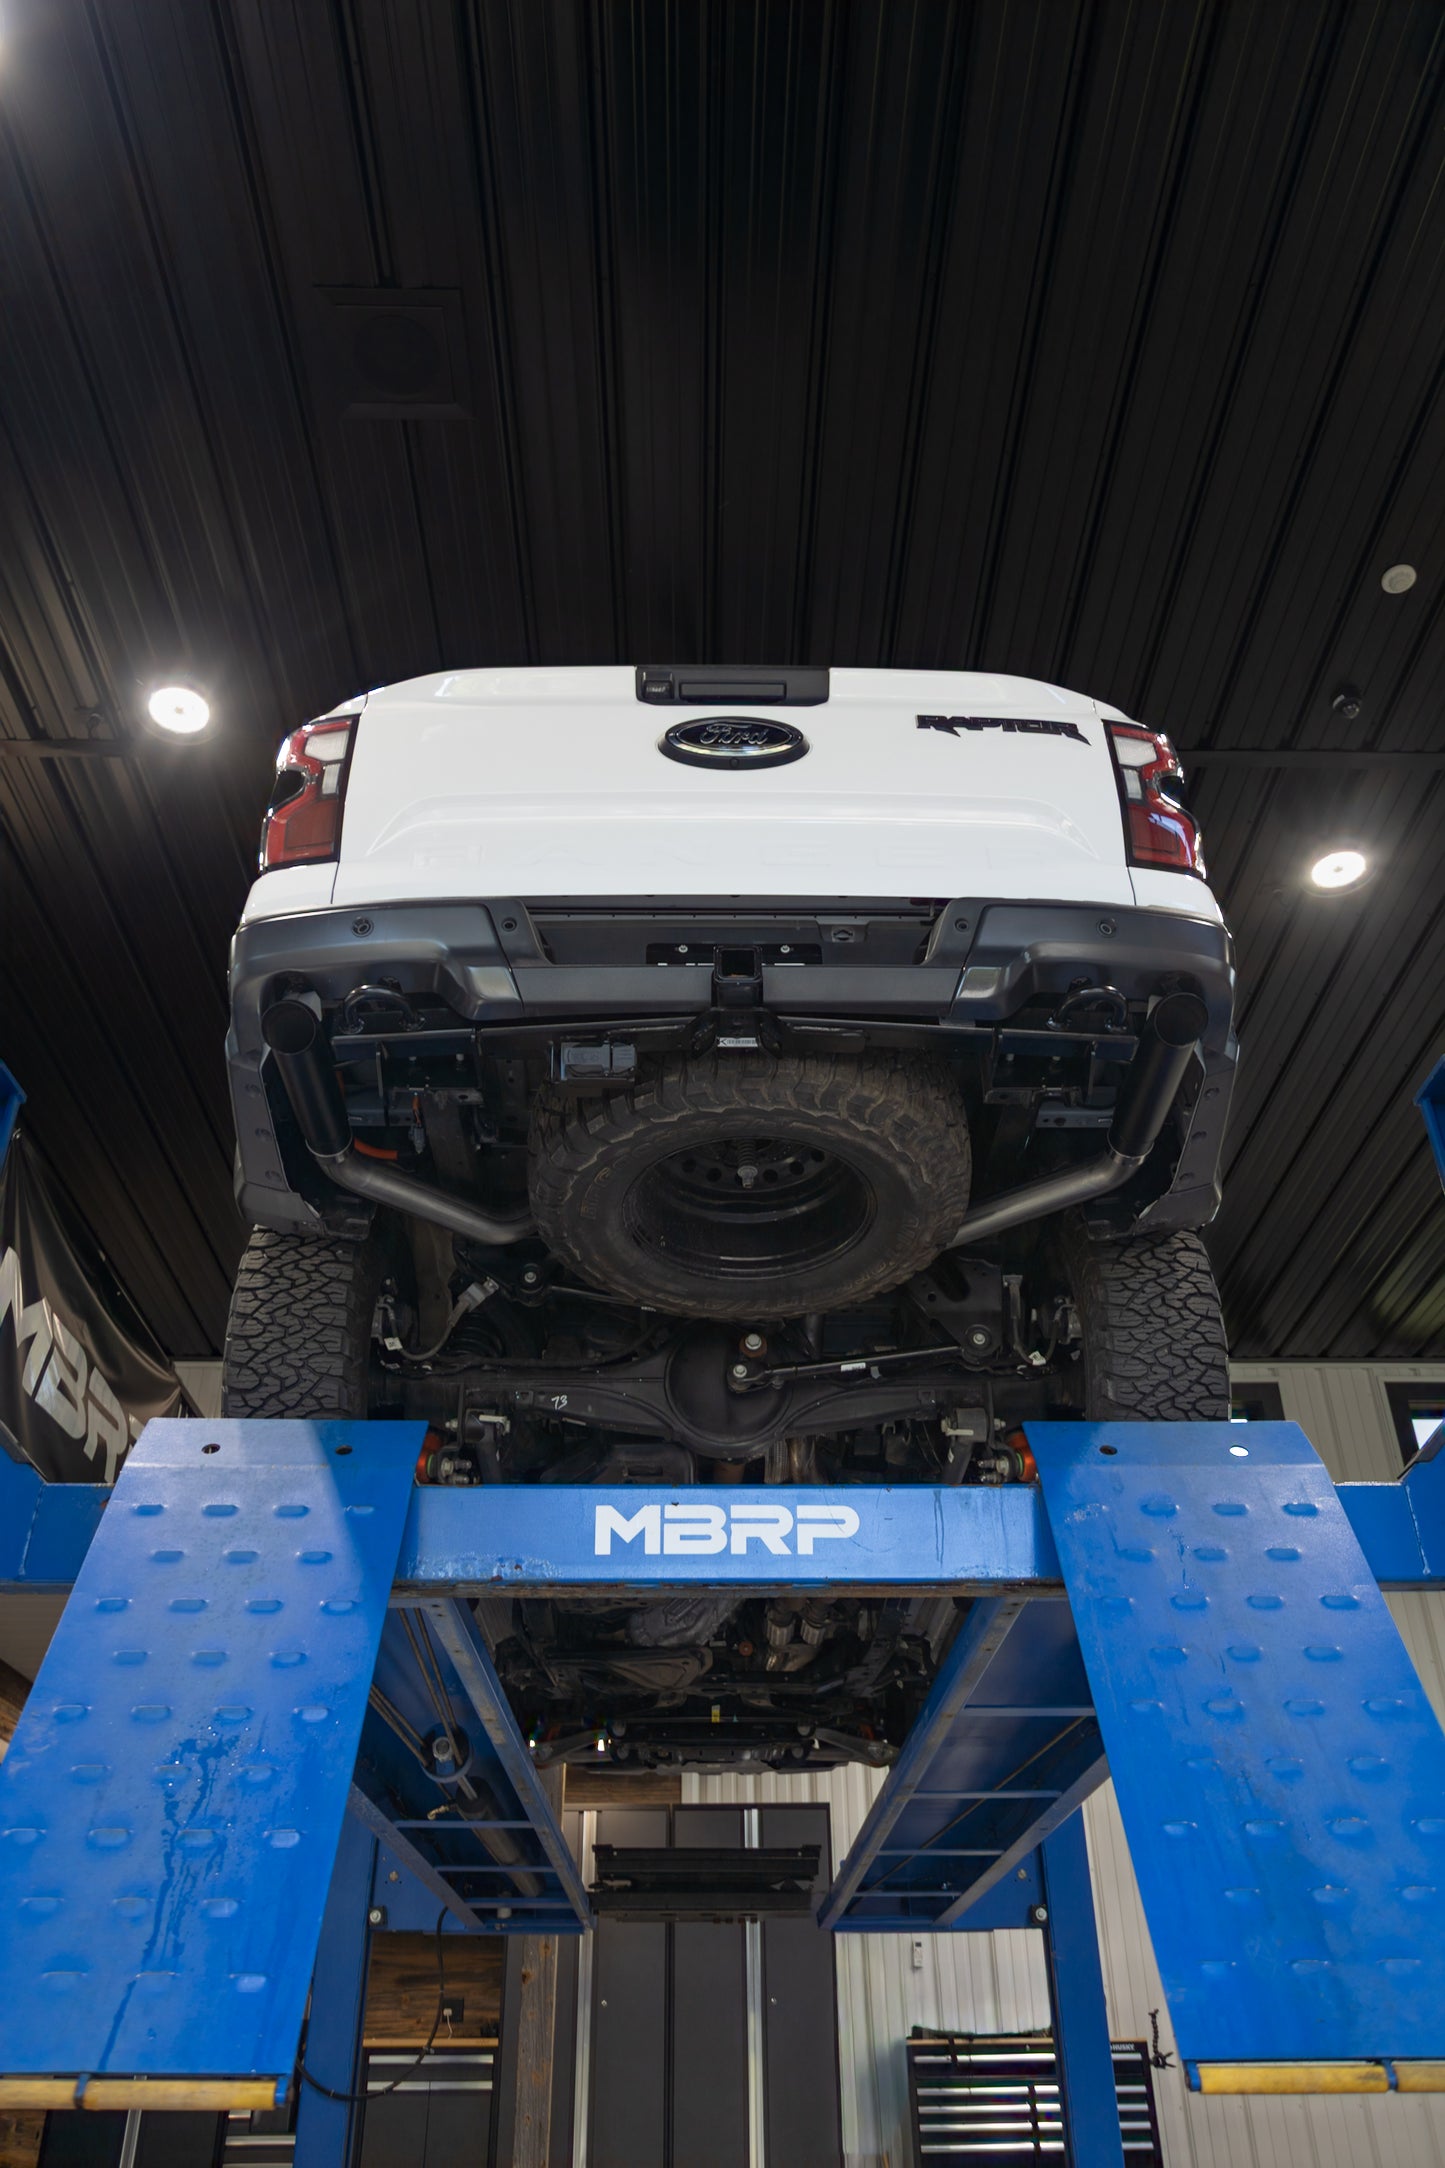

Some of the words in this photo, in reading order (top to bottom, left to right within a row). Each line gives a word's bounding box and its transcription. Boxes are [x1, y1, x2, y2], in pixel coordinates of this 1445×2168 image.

[700, 723, 769, 745] Ford
[916, 715, 1092, 746] RAPTOR
[0, 1246, 147, 1484] MBR
[551, 1394, 568, 1411] 73
[594, 1504, 860, 1556] MBRP
[1112, 2043, 1135, 2051] HUSKY
